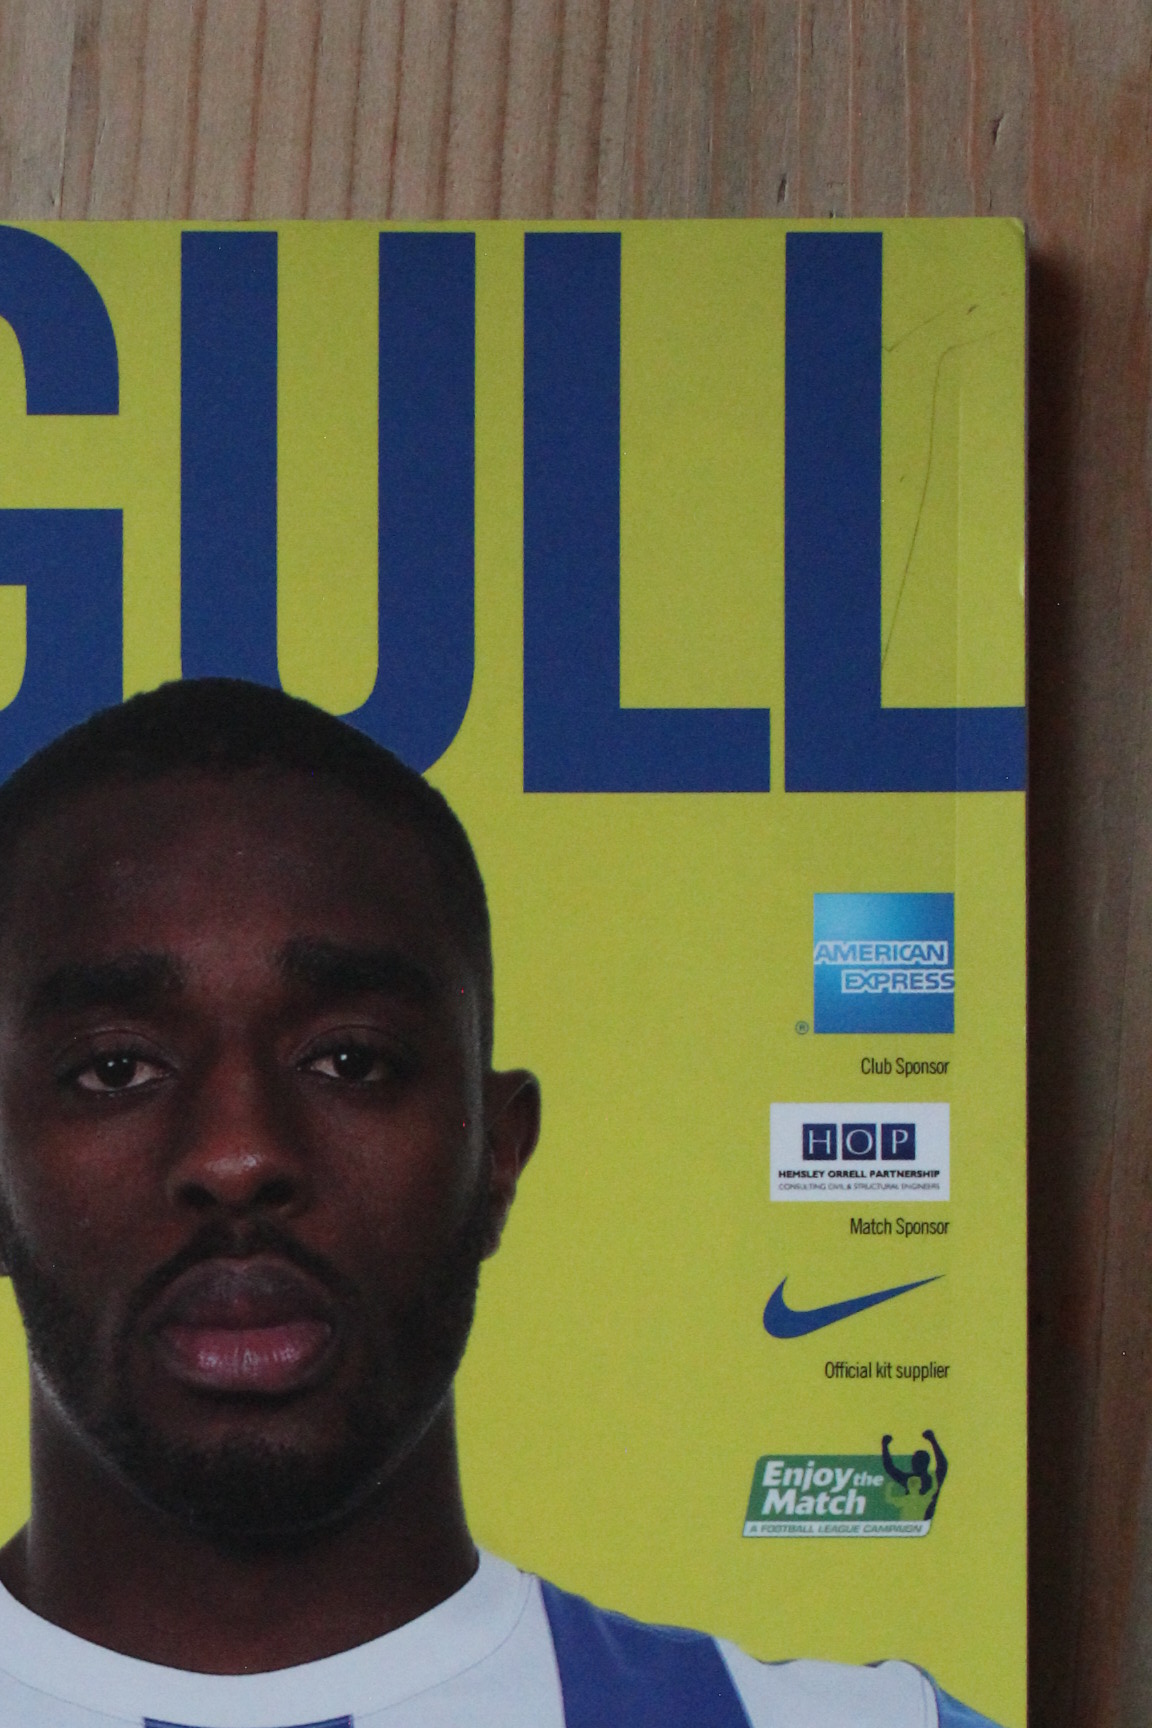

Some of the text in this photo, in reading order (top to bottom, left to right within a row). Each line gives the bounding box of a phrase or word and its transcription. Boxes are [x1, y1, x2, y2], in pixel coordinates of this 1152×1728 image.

[814, 940, 948, 965] AMERICAN
[841, 969, 955, 994] EXPRESS
[861, 1057, 950, 1078] Club Sponsor
[808, 1128, 909, 1156] HOP
[778, 1169, 940, 1179] HEMSLEY ORRELL PARTNERSHIP
[850, 1217, 950, 1238] Match Sponsor
[824, 1361, 950, 1382] Official kit supplier
[762, 1460, 885, 1493] Enjoy the
[761, 1488, 867, 1516] Match
[760, 1524, 814, 1534] FOOTBALL
[817, 1524, 861, 1534] LEAGUE
